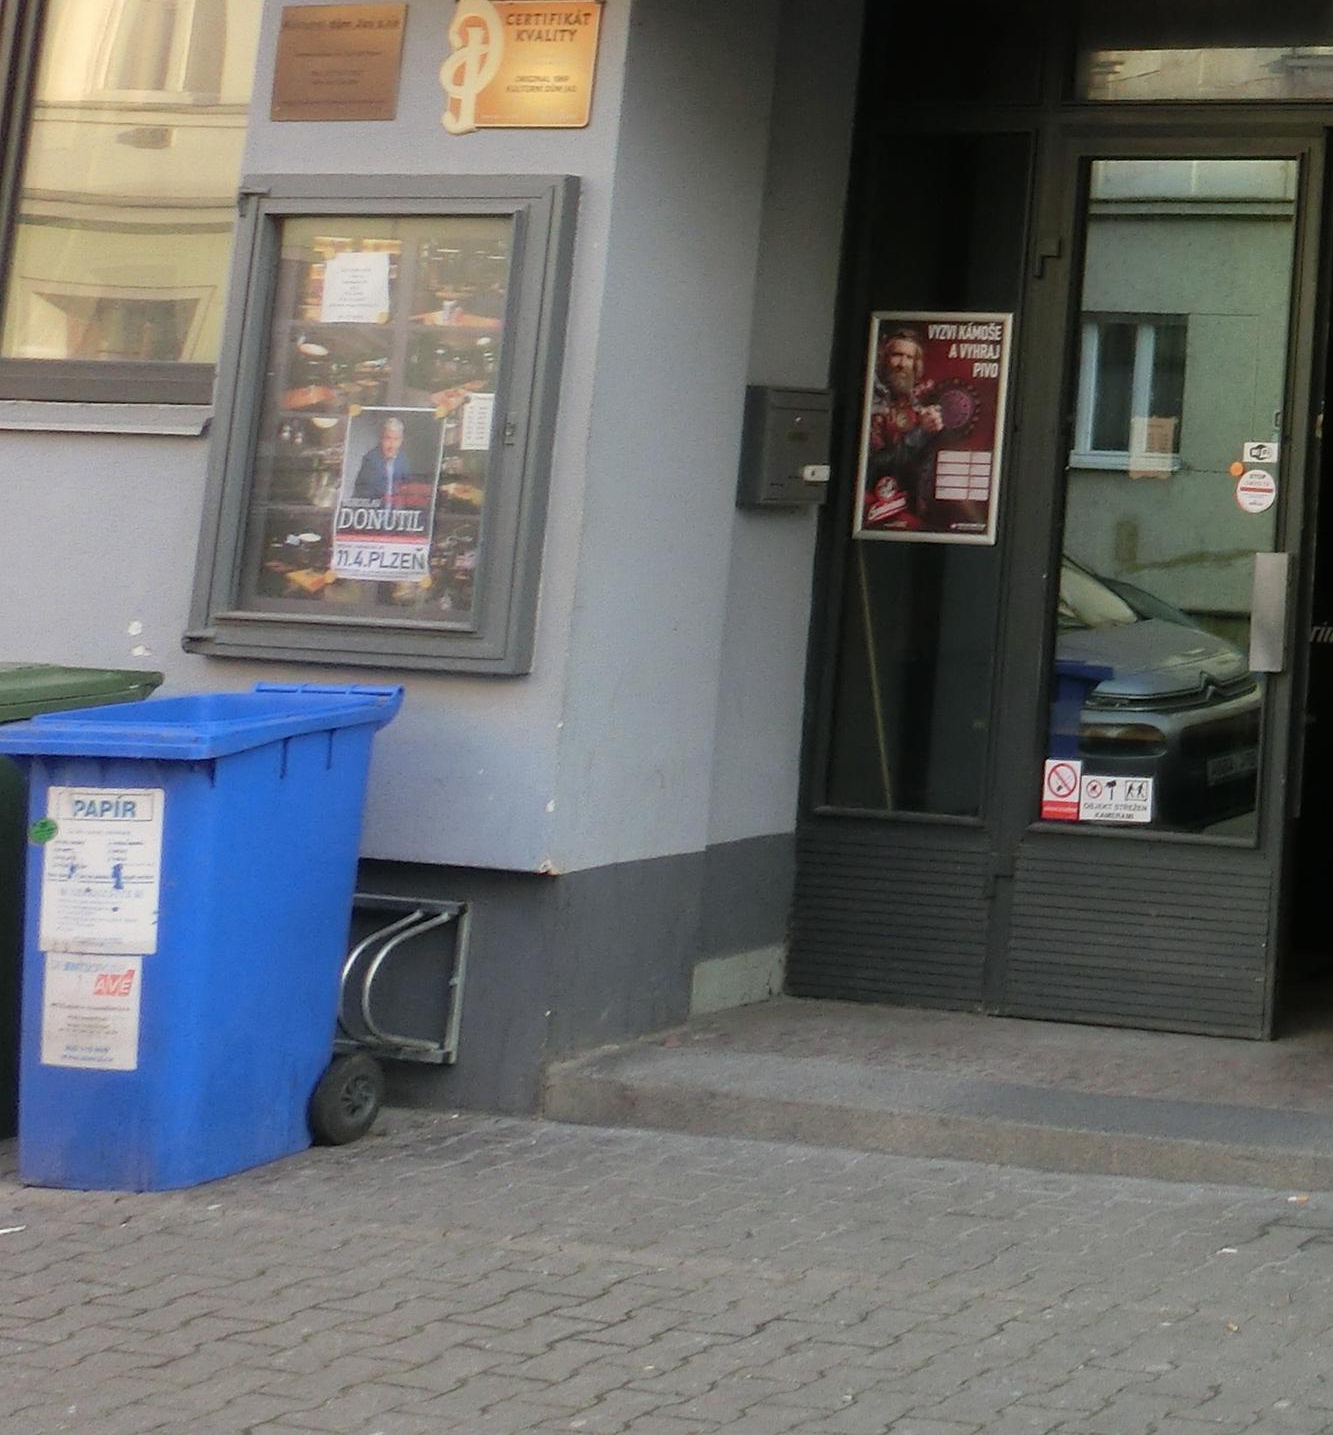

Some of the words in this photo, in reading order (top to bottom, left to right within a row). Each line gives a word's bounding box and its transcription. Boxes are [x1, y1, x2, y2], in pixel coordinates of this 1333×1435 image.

[505, 9, 592, 26] CERTIFIKÁT
[514, 28, 578, 42] KVALITY
[928, 325, 957, 340] VYZVI
[958, 322, 1003, 341] KÁMOŠE
[948, 344, 958, 358] A
[960, 344, 1001, 359] VYHRAJ
[972, 363, 999, 379] PIVO
[337, 507, 425, 532] DONUTIL
[72, 794, 137, 818] PAPÍR
